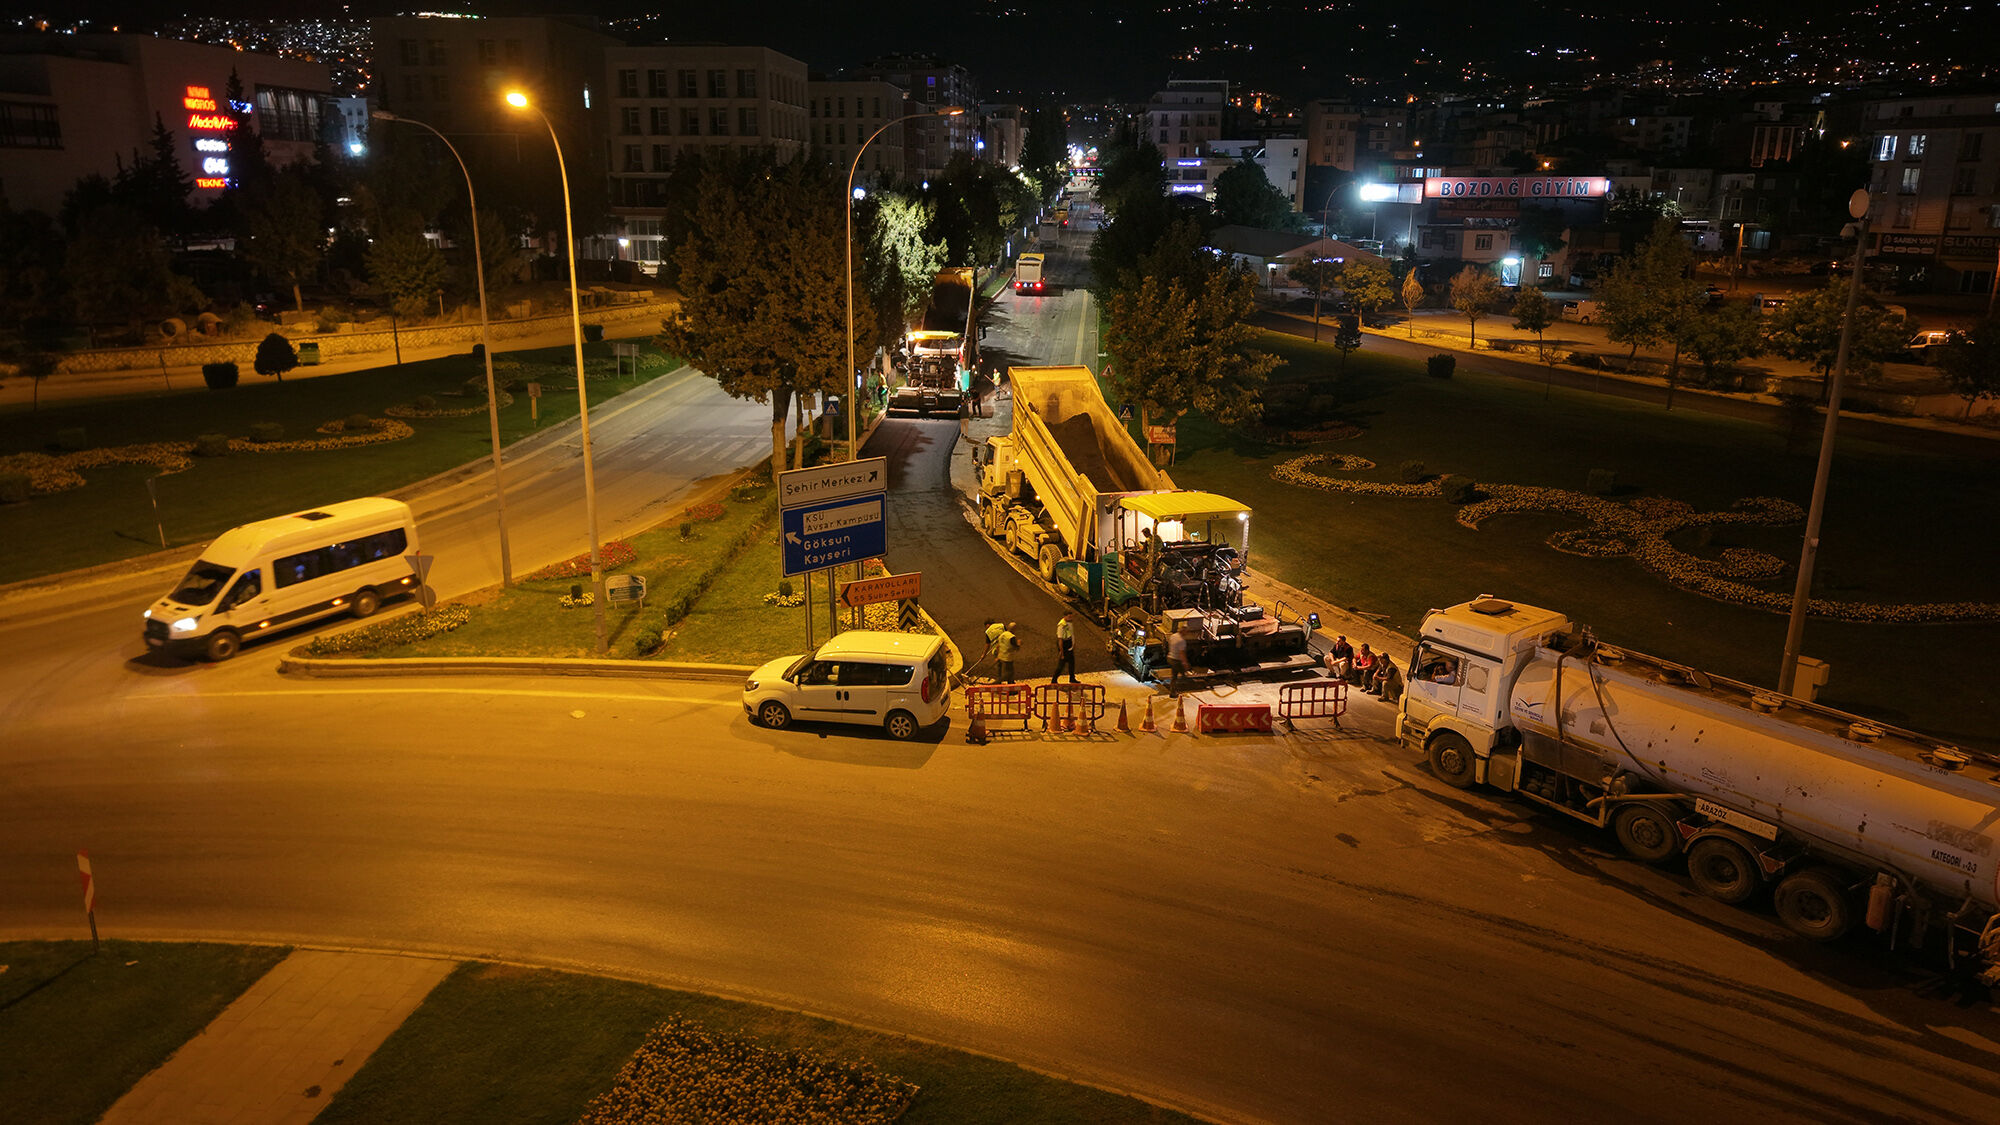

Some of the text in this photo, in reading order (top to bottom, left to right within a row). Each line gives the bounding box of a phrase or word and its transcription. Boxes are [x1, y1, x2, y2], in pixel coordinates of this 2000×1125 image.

[1440, 178, 1590, 196] BOZDAĞ GİYİM
[786, 475, 866, 496] Şehir Merkezi
[806, 521, 833, 532] Avşar
[803, 535, 851, 551] Göksun
[803, 547, 851, 565] Kayseri
[854, 578, 918, 593] KARAYOLLARI
[1931, 849, 1961, 867] KATEGORİ
